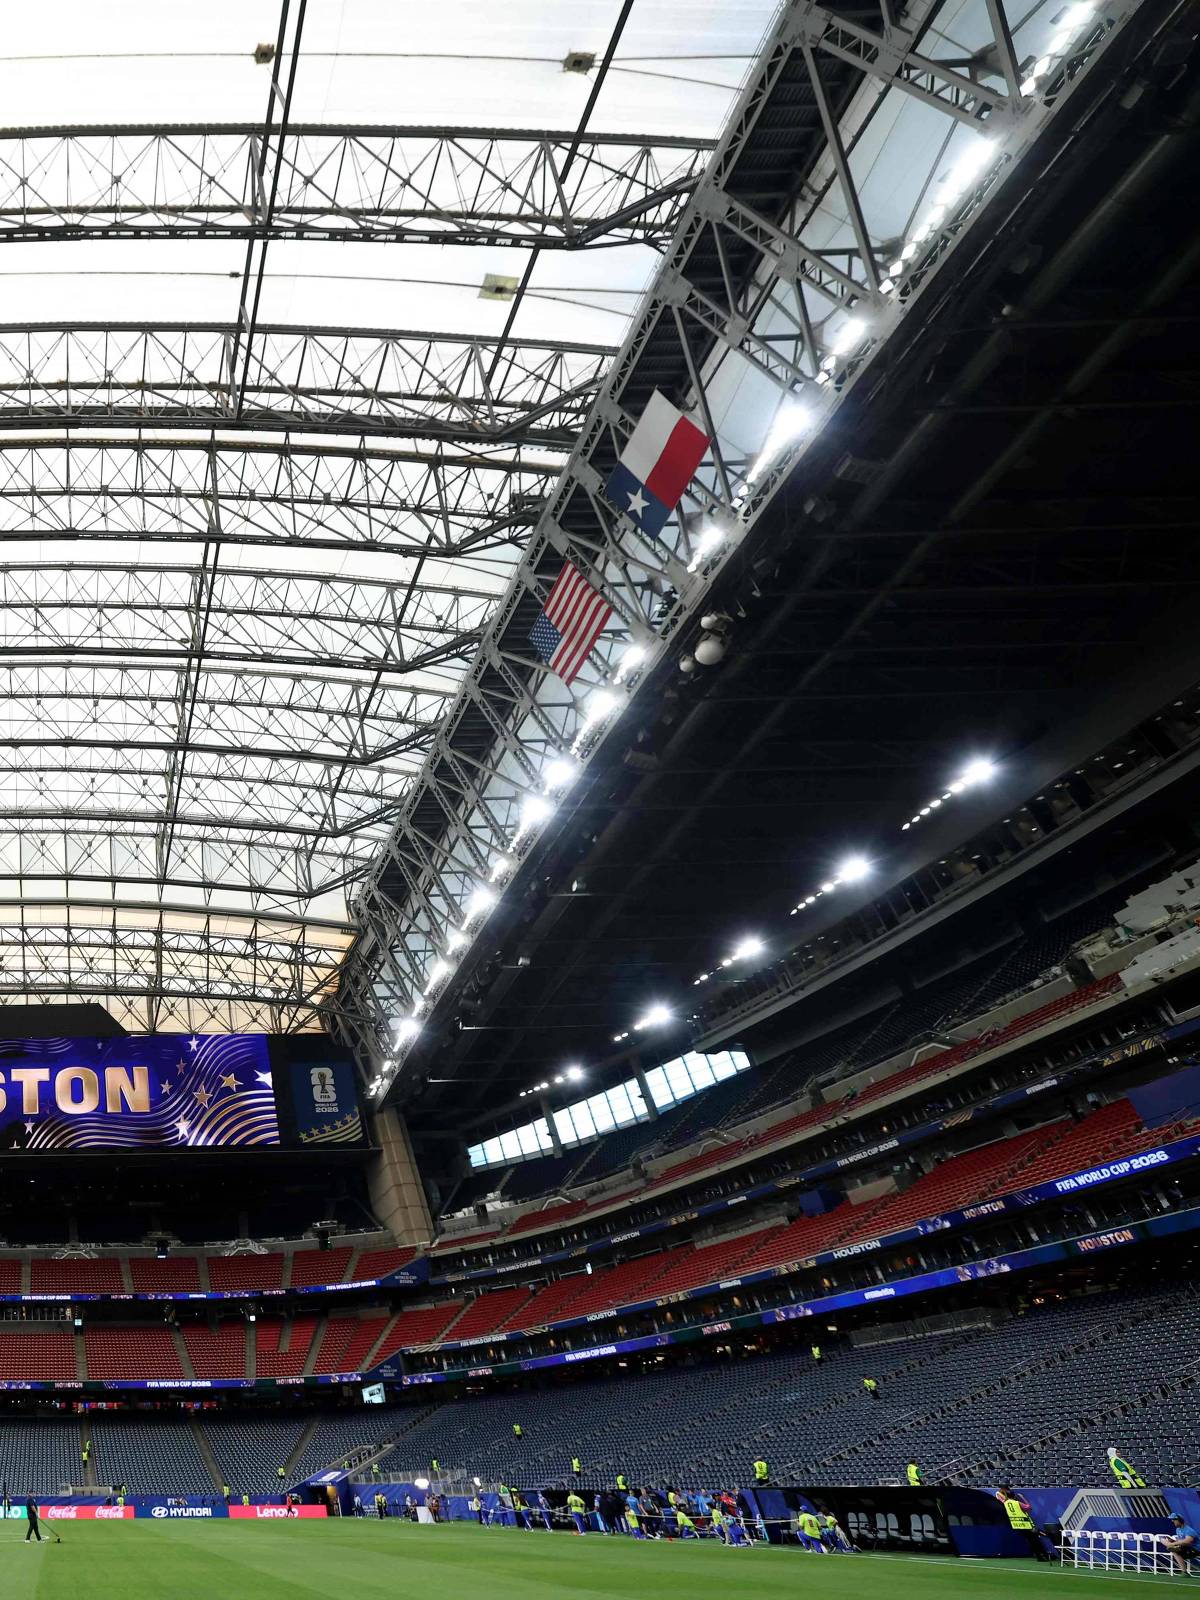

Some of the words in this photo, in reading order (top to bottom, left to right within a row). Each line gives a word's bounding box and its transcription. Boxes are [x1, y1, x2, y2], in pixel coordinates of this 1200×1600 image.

[837, 1158, 848, 1167] FIFA
[848, 1151, 868, 1165] WORLD
[867, 1146, 880, 1156] CUP
[879, 1138, 899, 1152] 2026
[1056, 1179, 1078, 1192] FIFA
[1076, 1167, 1110, 1188] WORLD
[1110, 1162, 1131, 1176] CUP
[1131, 1150, 1169, 1169] 2026
[962, 1200, 1006, 1220] HOUSTON
[610, 1230, 640, 1244] HOUSTON
[1076, 1230, 1134, 1252] HOUSTON
[832, 1240, 881, 1259] HOUSTON
[586, 1310, 617, 1322] HOUSTON
[170, 1508, 212, 1516] HYUNDAI
